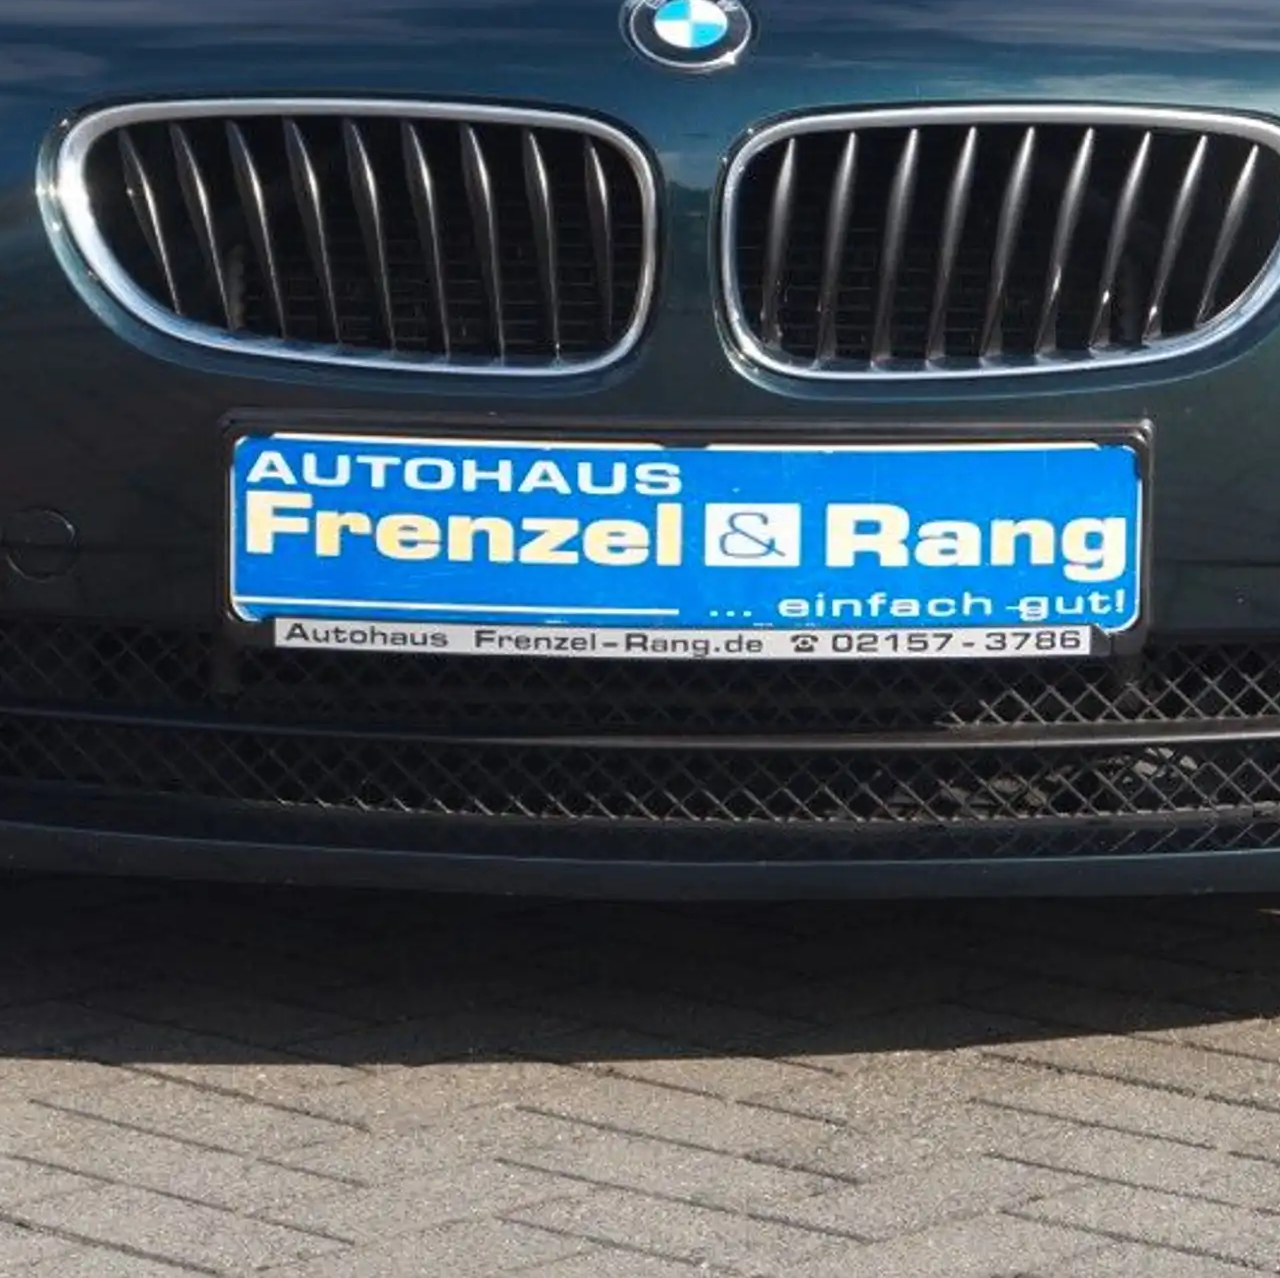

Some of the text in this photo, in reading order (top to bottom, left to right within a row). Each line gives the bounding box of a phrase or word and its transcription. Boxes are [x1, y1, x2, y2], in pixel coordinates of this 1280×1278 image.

[246, 451, 682, 495] AUTOHAUS
[246, 490, 1127, 582] Frenzel & Rang
[777, 591, 993, 619] einfach
[285, 623, 450, 649] Autohaus
[474, 629, 764, 659] Frenzel-Rang.de
